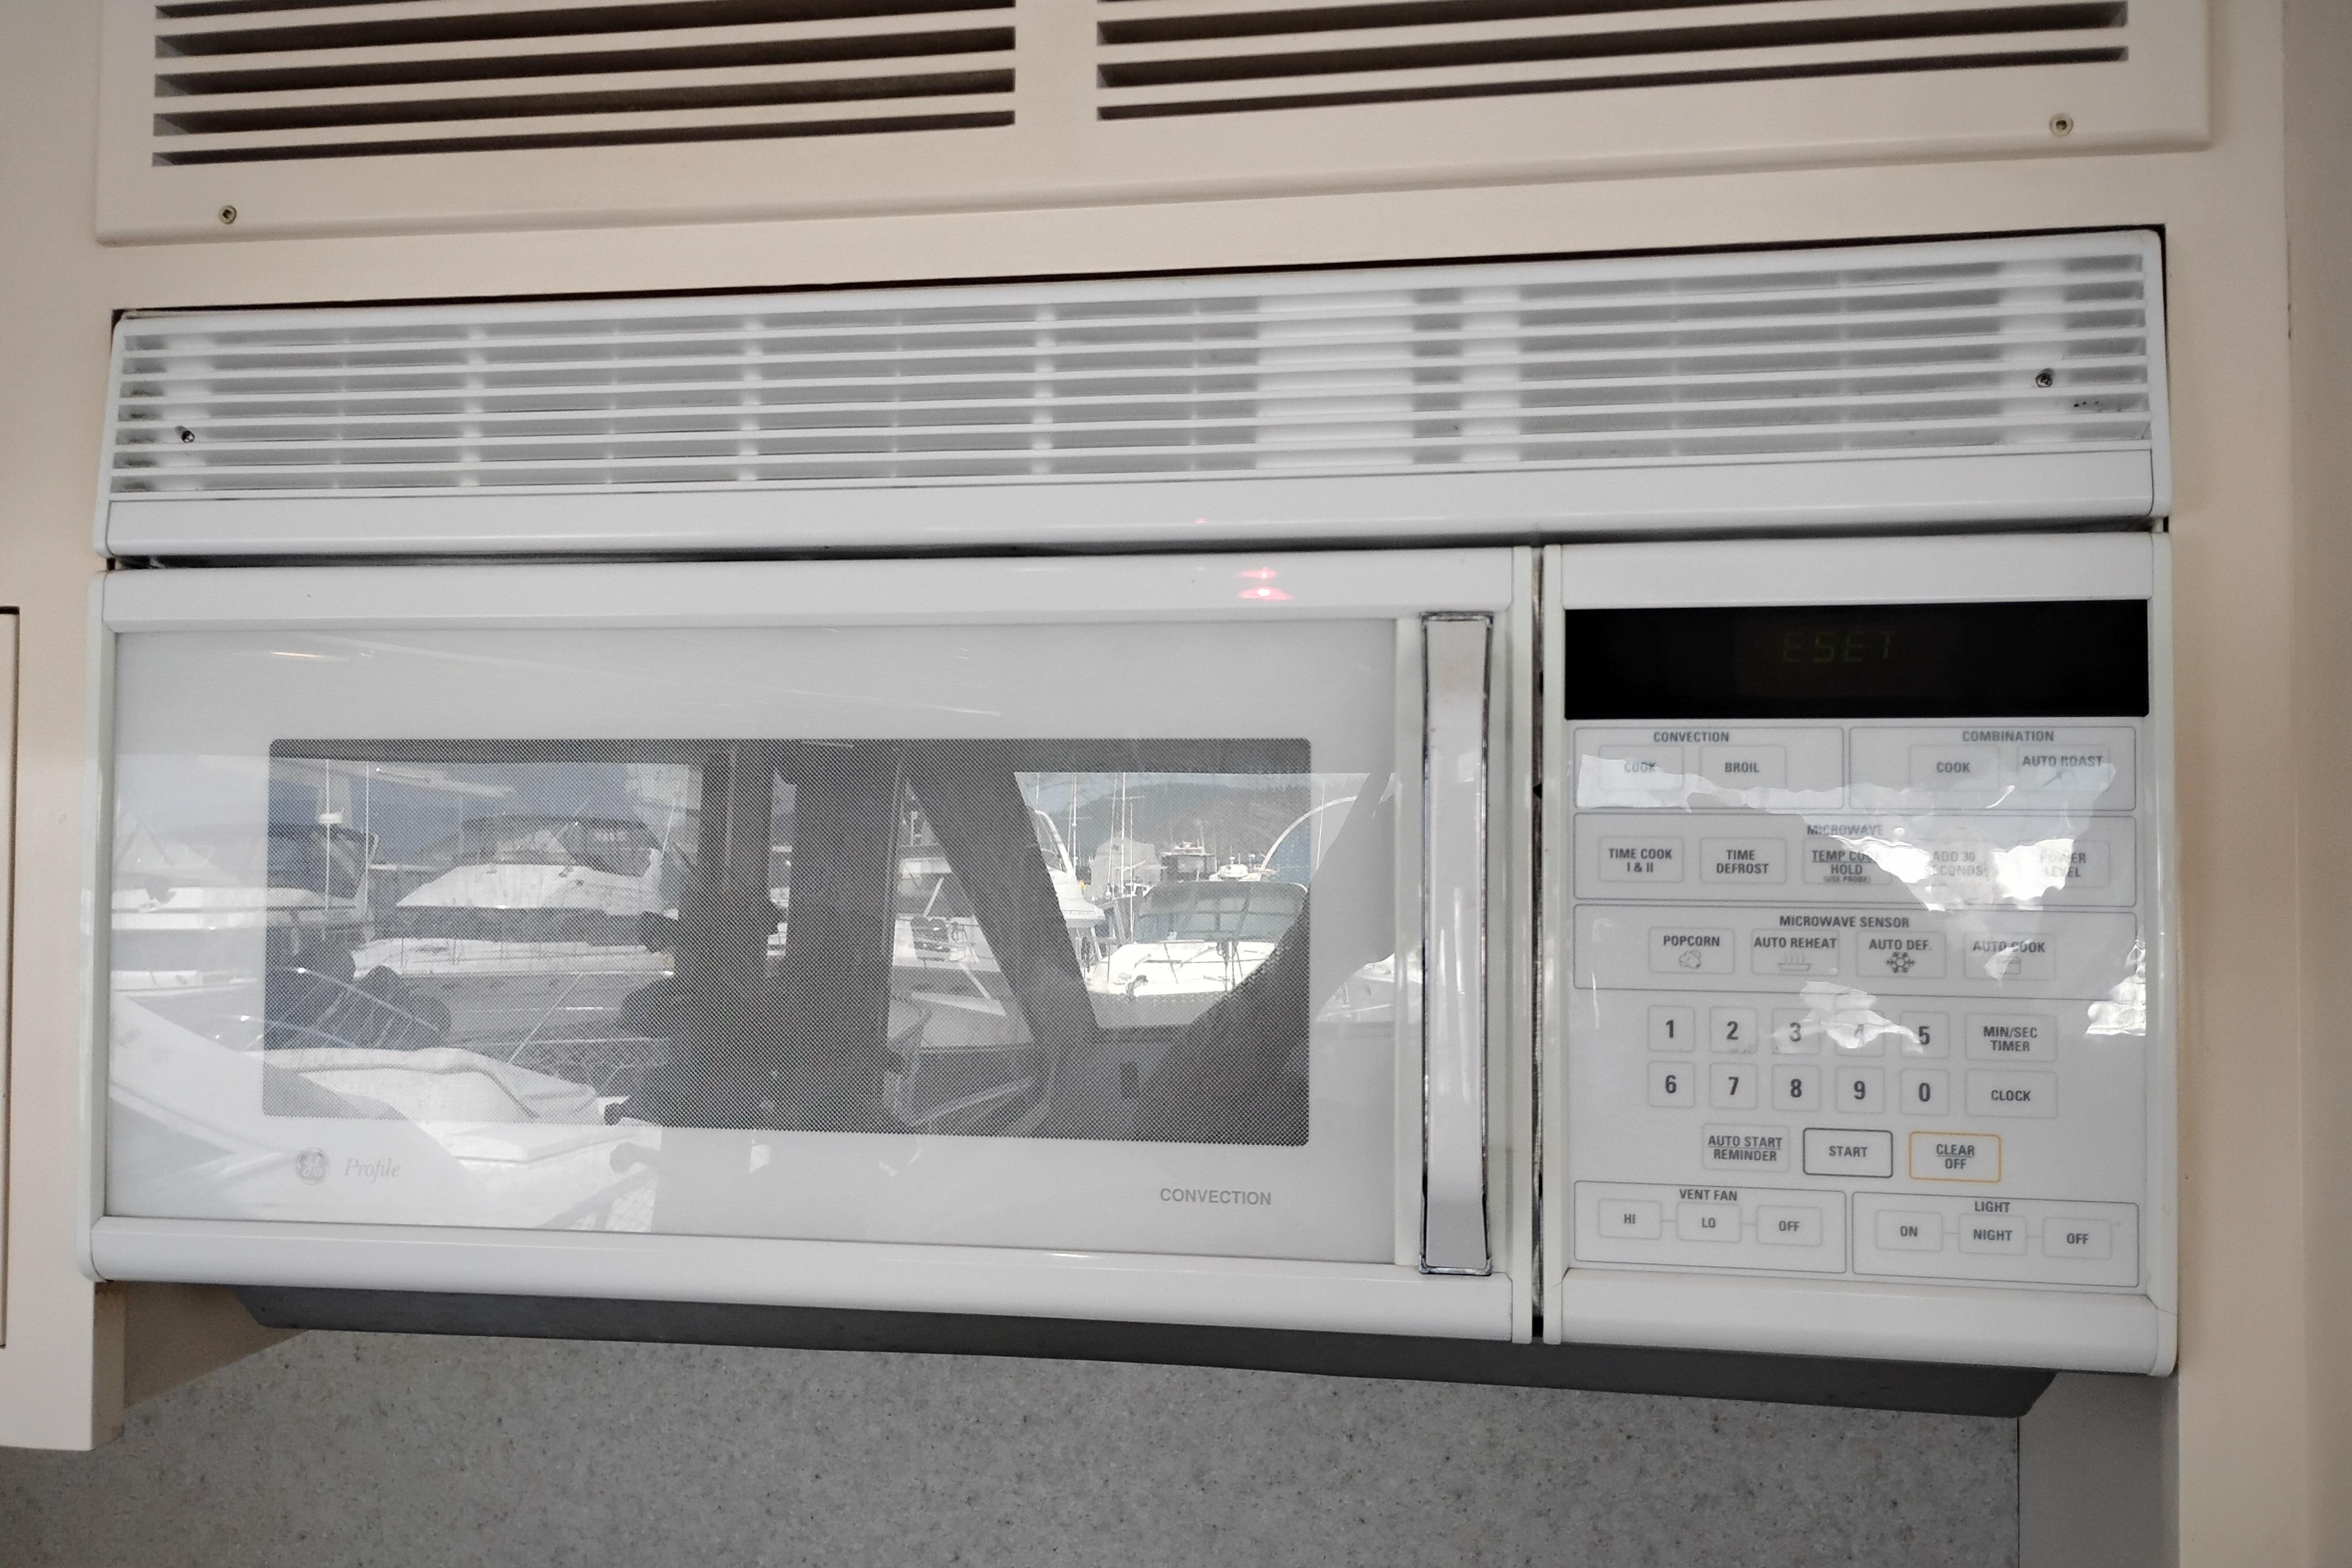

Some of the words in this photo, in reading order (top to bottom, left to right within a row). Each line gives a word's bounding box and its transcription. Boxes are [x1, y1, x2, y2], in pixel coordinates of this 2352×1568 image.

[1653, 732, 1729, 742] CONVECTION
[1962, 731, 2054, 742] COMBINATION
[1624, 762, 1656, 772] COOK
[2023, 756, 2056, 767] AUTO
[2061, 756, 2103, 767] ROAST
[1724, 762, 1759, 773] BROIL
[1936, 762, 1970, 773] COOK
[1807, 824, 1883, 835] MICROWAVE
[1609, 849, 1636, 859] TIME
[1641, 849, 1672, 860] COOK
[1727, 850, 1755, 860] TIME
[1812, 850, 1845, 861] TEMP
[1933, 851, 1958, 862] ADD
[1962, 851, 1976, 862] 30
[1627, 862, 1630, 872] I
[1634, 862, 1642, 873] &
[1646, 863, 1653, 873] II
[1716, 864, 1769, 875] DEFROST
[1831, 864, 1863, 875] HOLD
[1780, 916, 1856, 927] MICROWAVE
[1860, 917, 1909, 928] SENSOR
[1664, 935, 1720, 947] POPCORN
[1754, 937, 1786, 948] AUTO
[1791, 938, 1837, 948] REHEAT
[1869, 939, 1902, 950] AUTO
[1907, 940, 1931, 951] DEF.
[1973, 941, 2007, 952] AUTO
[2011, 941, 2045, 952] COOK
[1666, 1020, 1673, 1038] 1
[1727, 1021, 1739, 1040] 2
[1790, 1022, 1801, 1042] 3
[1983, 1026, 2037, 1038] MIN/SEC
[1918, 1026, 1930, 1045] 5
[1991, 1040, 2030, 1051] TIMER
[1665, 1075, 1676, 1094] 6
[1728, 1076, 1739, 1095] 7
[1790, 1079, 1801, 1098] 8
[1854, 1081, 1865, 1100] 9
[1918, 1083, 1931, 1102] 0
[1991, 1090, 2031, 1101] CLOCK
[1708, 1135, 1740, 1147] AUTO
[1744, 1137, 1782, 1148] START
[1714, 1149, 1777, 1161] REMINDER
[1829, 1145, 1867, 1158] START
[1936, 1144, 1974, 1156] CLEAR
[1945, 1158, 1966, 1169] OFF
[344, 1157, 401, 1183] Profile
[1160, 1188, 1271, 1205] CONVECTION
[1679, 1189, 1710, 1200] VENT
[1714, 1190, 1737, 1201] FAN
[1974, 1201, 2010, 1212] LIGHT
[1624, 1214, 1635, 1224] HI
[1702, 1218, 1716, 1228] LO
[1778, 1220, 1799, 1231] OFF
[1900, 1226, 1918, 1237] ON
[1973, 1229, 2012, 1241] NIGHT
[2067, 1233, 2089, 1245] OFF
